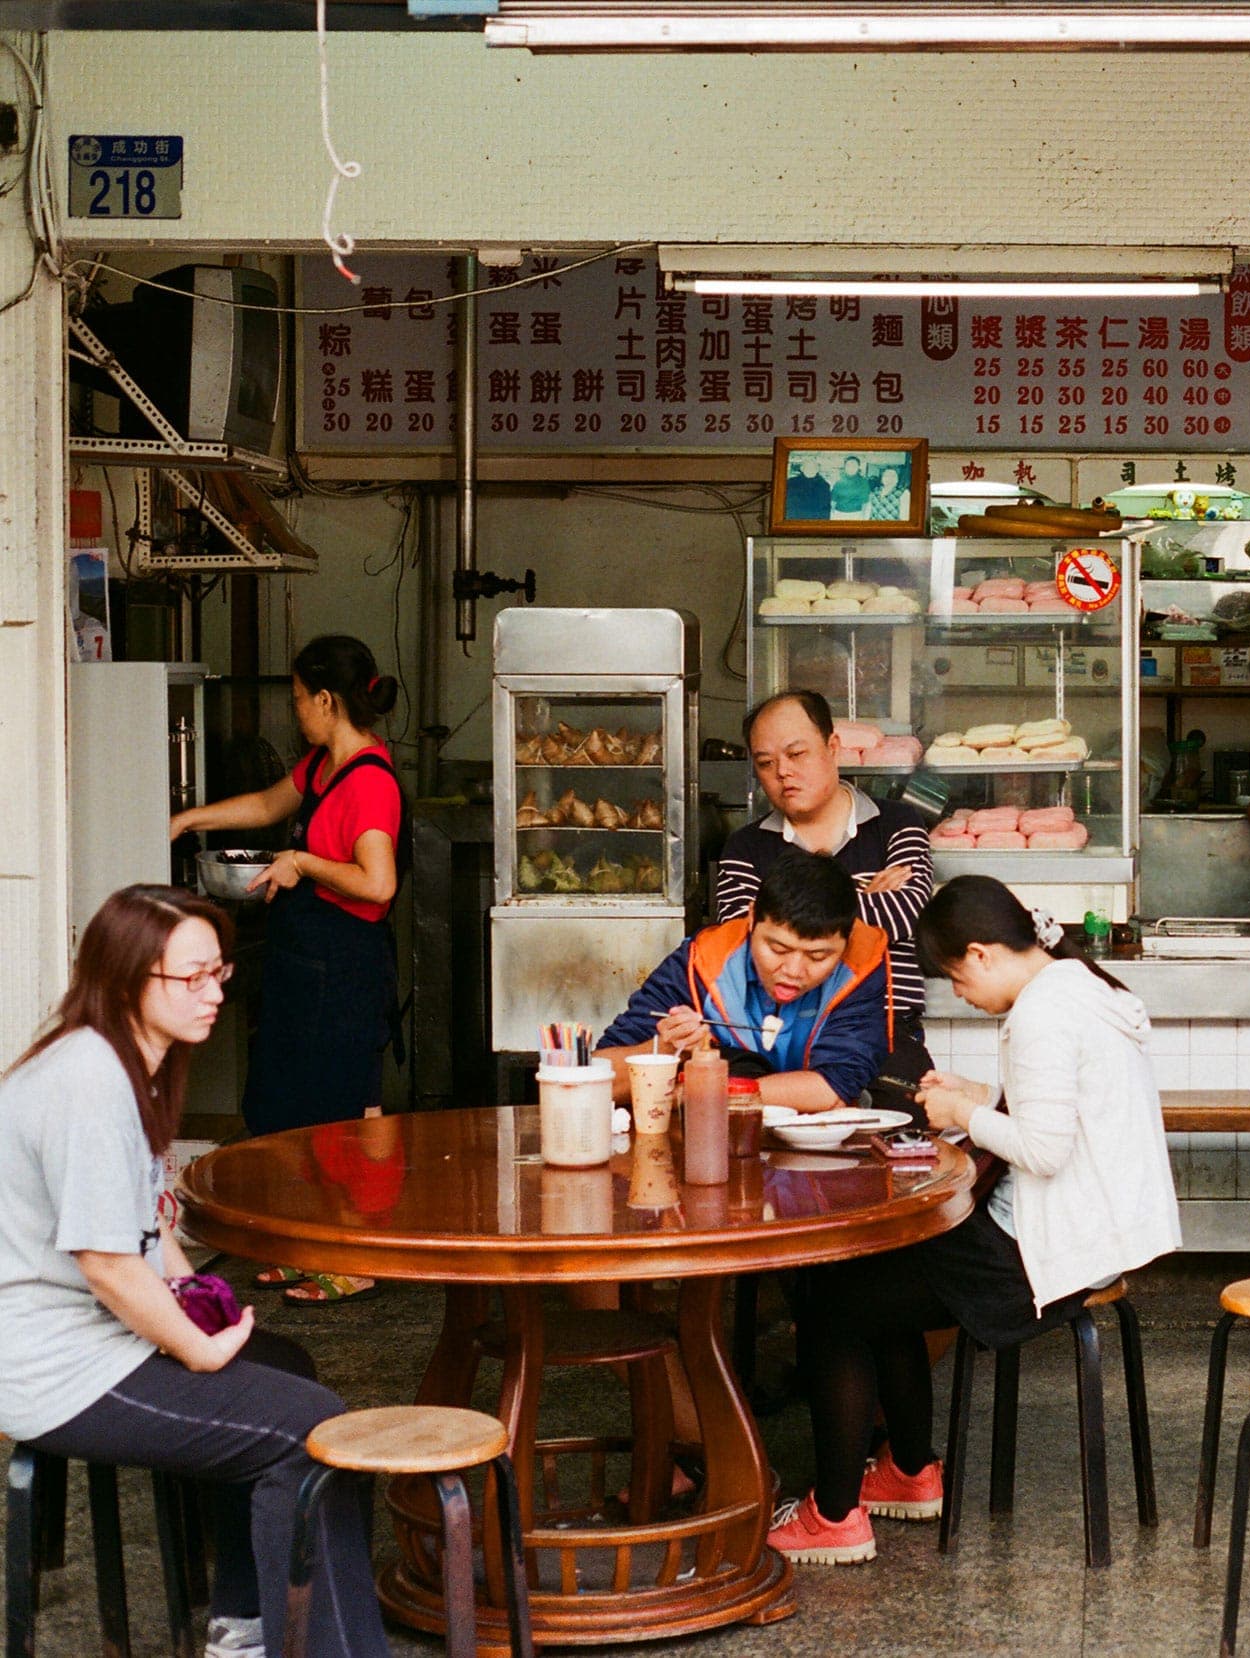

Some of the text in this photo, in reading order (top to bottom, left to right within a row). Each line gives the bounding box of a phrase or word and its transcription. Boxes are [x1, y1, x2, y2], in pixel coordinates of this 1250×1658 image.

[112, 140, 169, 154] 成功街
[89, 170, 156, 215] 218
[319, 323, 351, 357] 粽
[1056, 316, 1088, 350] 茶
[1099, 316, 1130, 350] 仁
[974, 358, 1001, 377] 25
[1017, 358, 1044, 377] 25
[1057, 358, 1086, 377] 35
[1101, 358, 1129, 377] 25
[1142, 358, 1169, 377] 60
[1182, 358, 1209, 377] 60
[323, 377, 350, 396] 35
[572, 368, 604, 404] 餅
[974, 386, 1001, 405] 20
[1017, 386, 1044, 405] 20
[1057, 386, 1086, 405] 30
[1101, 386, 1129, 405] 20
[1142, 386, 1169, 405] 40
[1182, 386, 1209, 405] 40
[323, 413, 904, 432] 30 20 20 30 25 20 20 35 25 30 15 20 20
[976, 415, 1001, 435] 15
[1019, 415, 1044, 435] 15
[1058, 415, 1087, 435] 25
[1103, 415, 1128, 435] 15
[1143, 415, 1169, 435] 30
[1183, 415, 1210, 435] 30
